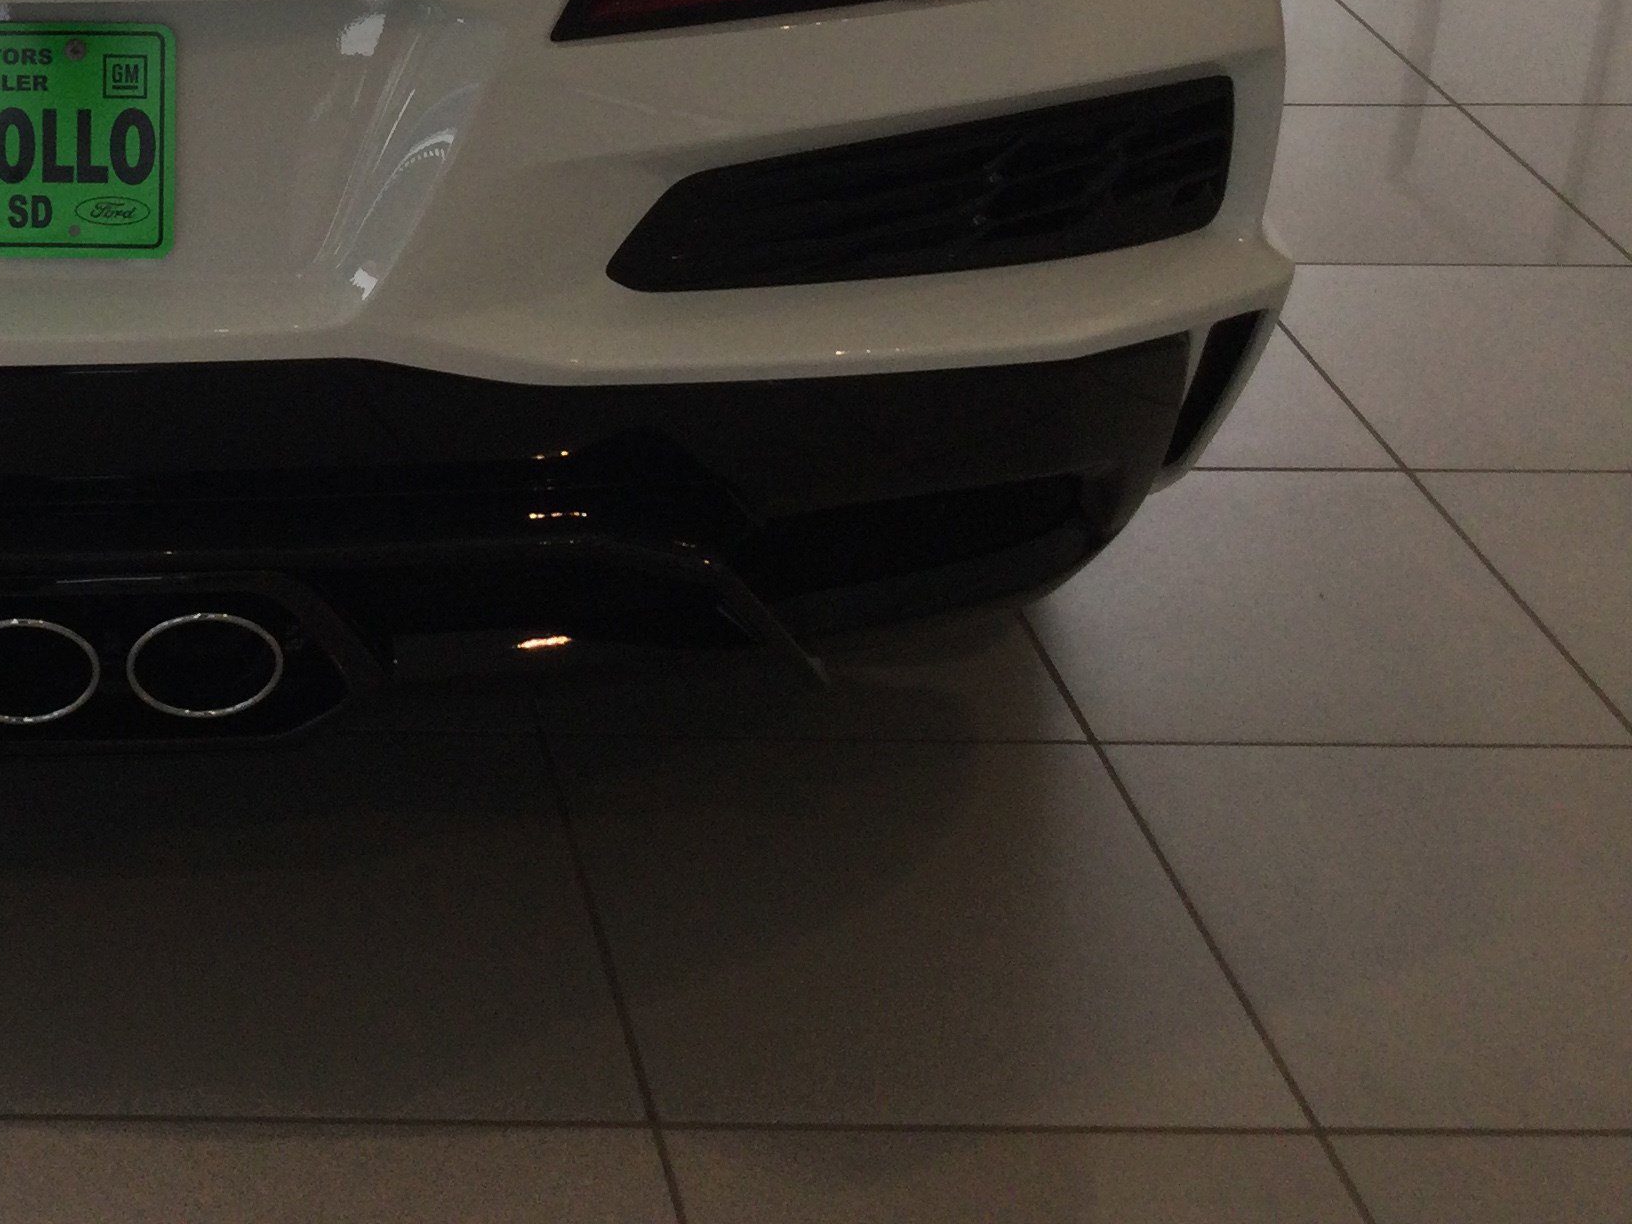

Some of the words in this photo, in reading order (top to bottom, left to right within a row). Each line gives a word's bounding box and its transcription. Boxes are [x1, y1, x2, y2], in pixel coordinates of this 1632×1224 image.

[111, 63, 140, 84] GM
[7, 193, 54, 230] SD
[90, 199, 137, 222] Ford
